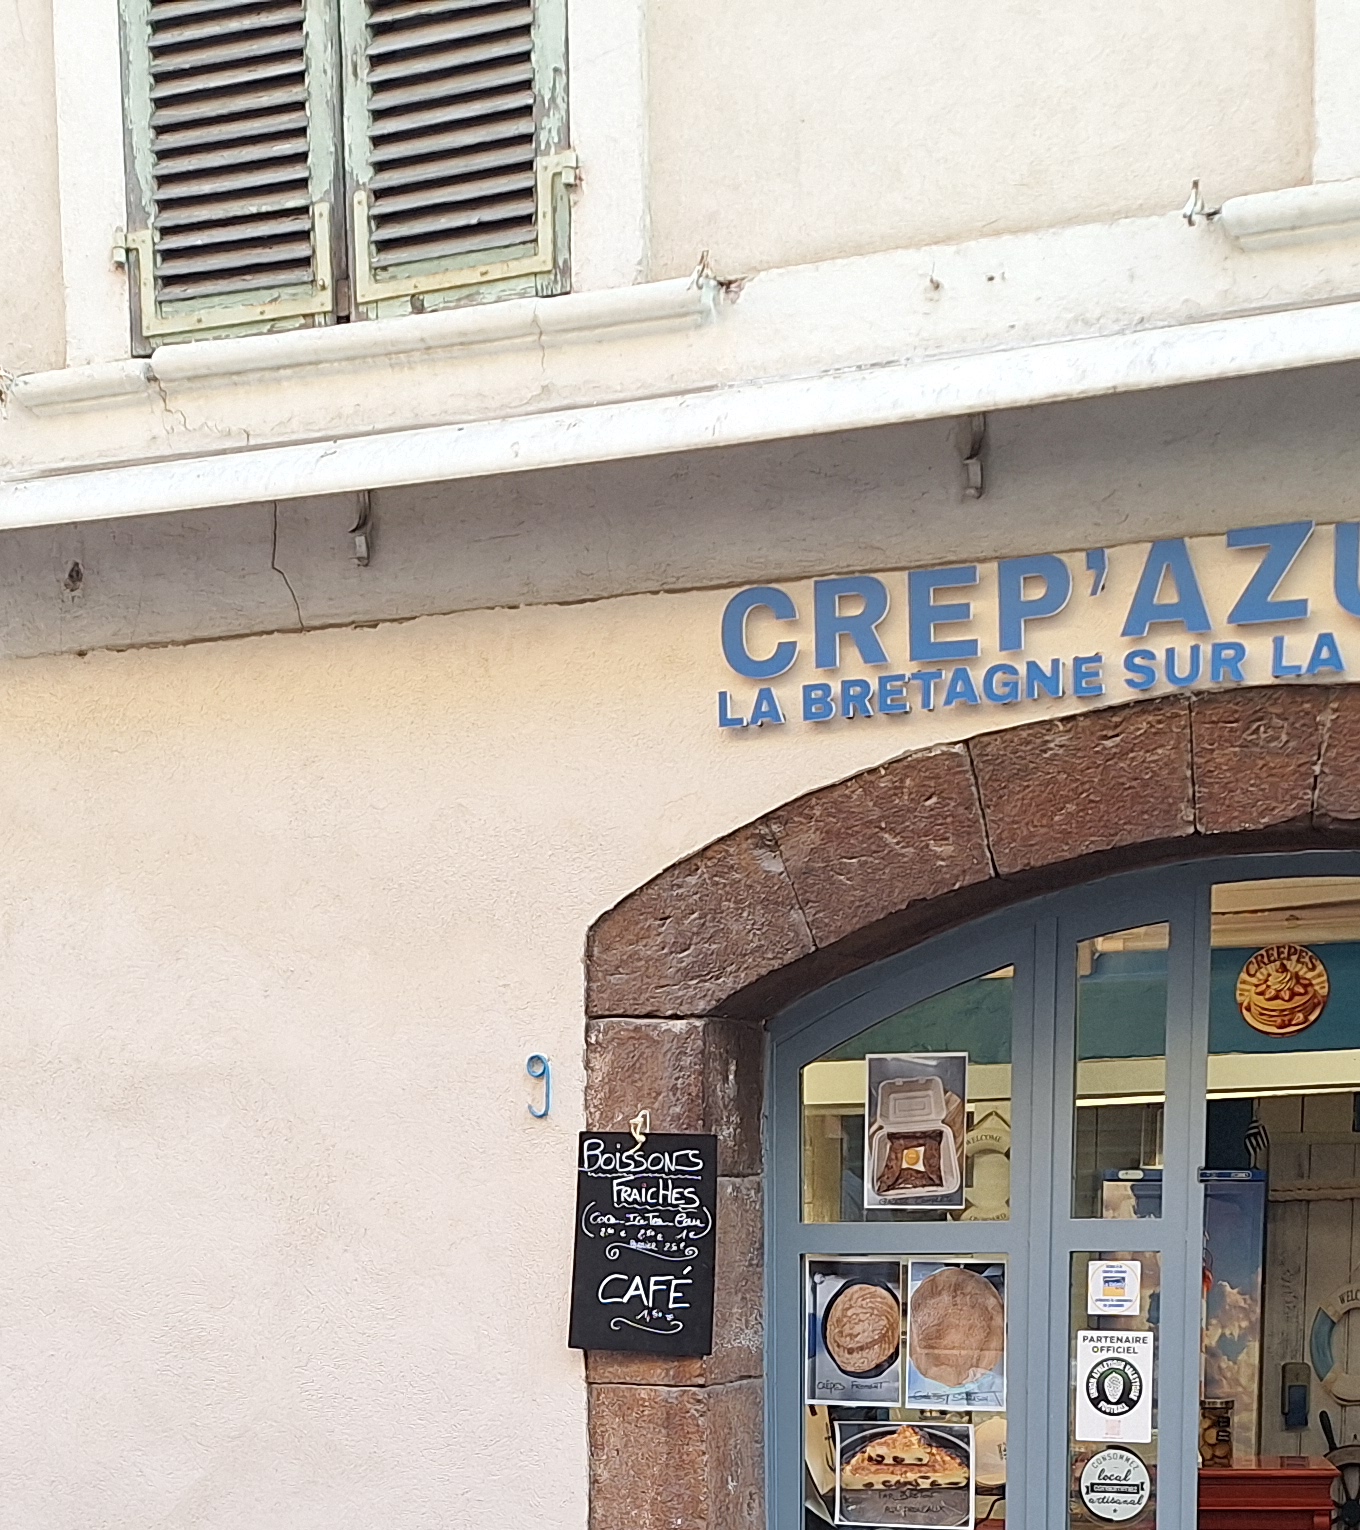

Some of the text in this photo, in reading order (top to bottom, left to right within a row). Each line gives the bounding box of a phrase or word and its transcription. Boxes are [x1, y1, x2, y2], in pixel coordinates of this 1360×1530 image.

[717, 687, 786, 728] LA
[802, 653, 1105, 722] BRETAGNE
[1123, 642, 1246, 692] SUR
[1272, 629, 1343, 678] LA
[598, 1265, 693, 1309] CAFÉ
[1083, 1335, 1148, 1345] PARTENAIRE
[1092, 1346, 1139, 1355] OFFICIEL
[1091, 1453, 1139, 1471] CONSOMMEZ
[1098, 1468, 1132, 1482] local
